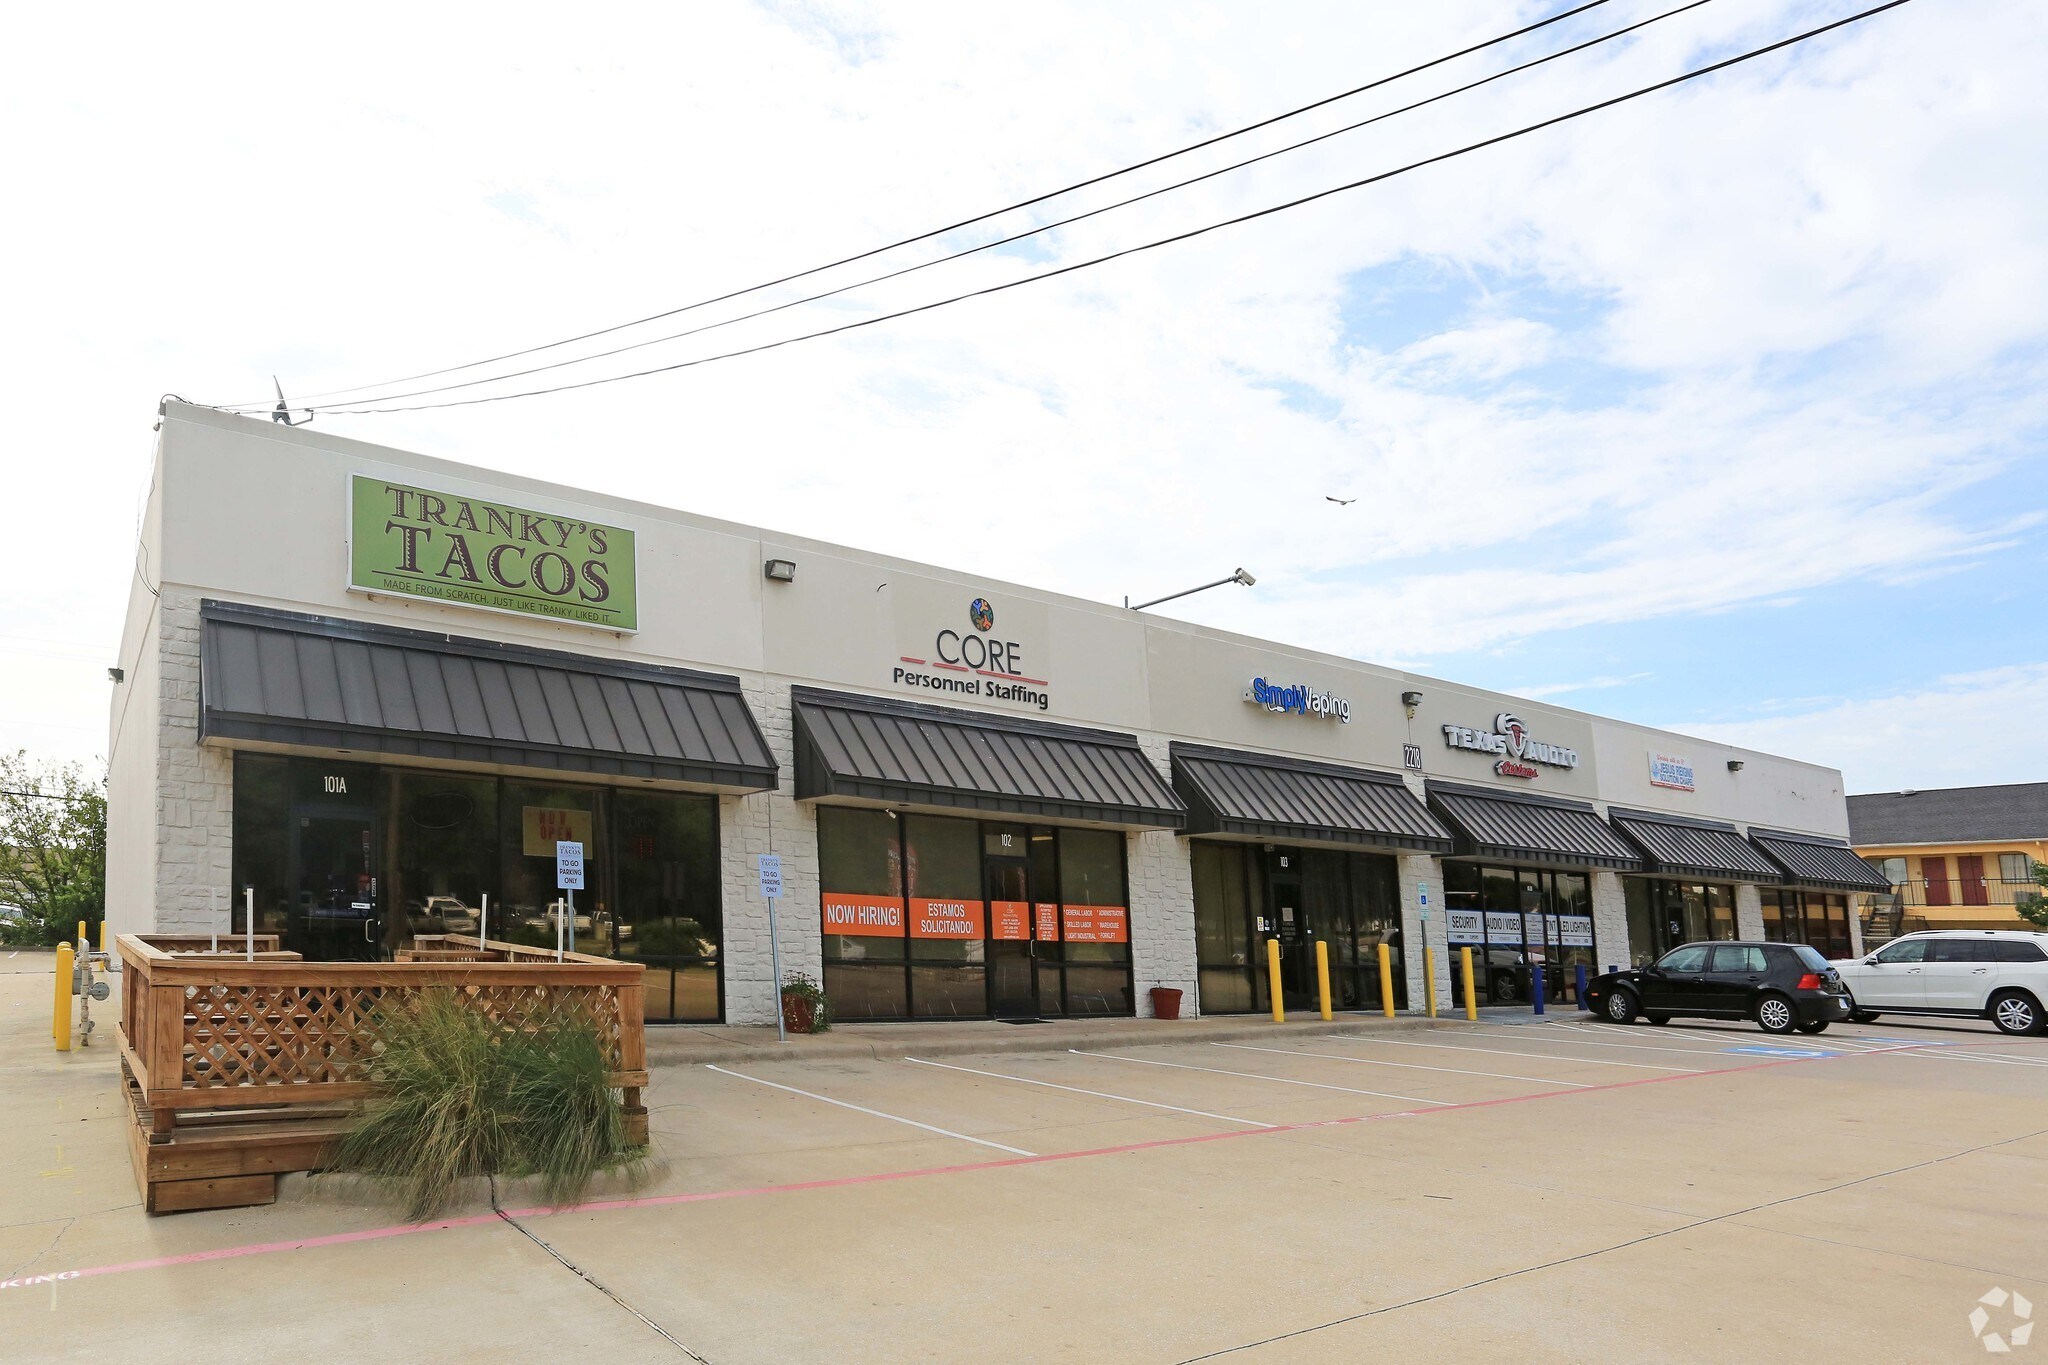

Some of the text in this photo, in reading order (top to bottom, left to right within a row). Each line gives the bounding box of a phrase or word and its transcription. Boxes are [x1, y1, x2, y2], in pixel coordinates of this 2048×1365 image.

[385, 485, 608, 555] TRANKY'S
[385, 520, 610, 603] TACOS
[383, 578, 611, 623] MADE FROM SCRATCH. JUST LIKE TRANKY LIKED IT.
[936, 629, 1022, 676] CORE
[893, 667, 1049, 710] Personnel Staffing
[1443, 725, 1579, 769] TEXAS AUDIO
[1660, 763, 1675, 775] JESUS
[324, 776, 347, 793] 101A
[540, 825, 572, 841] OPEN
[1000, 833, 1012, 847] 102
[827, 904, 900, 926] NOW HIRING!
[928, 903, 965, 918] ESTAMOS
[921, 919, 974, 934] SOLICITANDO!
[1452, 915, 1477, 929] SECURITY
[1486, 917, 1502, 930] AUDIO
[1505, 918, 1520, 931] VIDEO
[1560, 921, 1590, 933] LED LIGHTING
